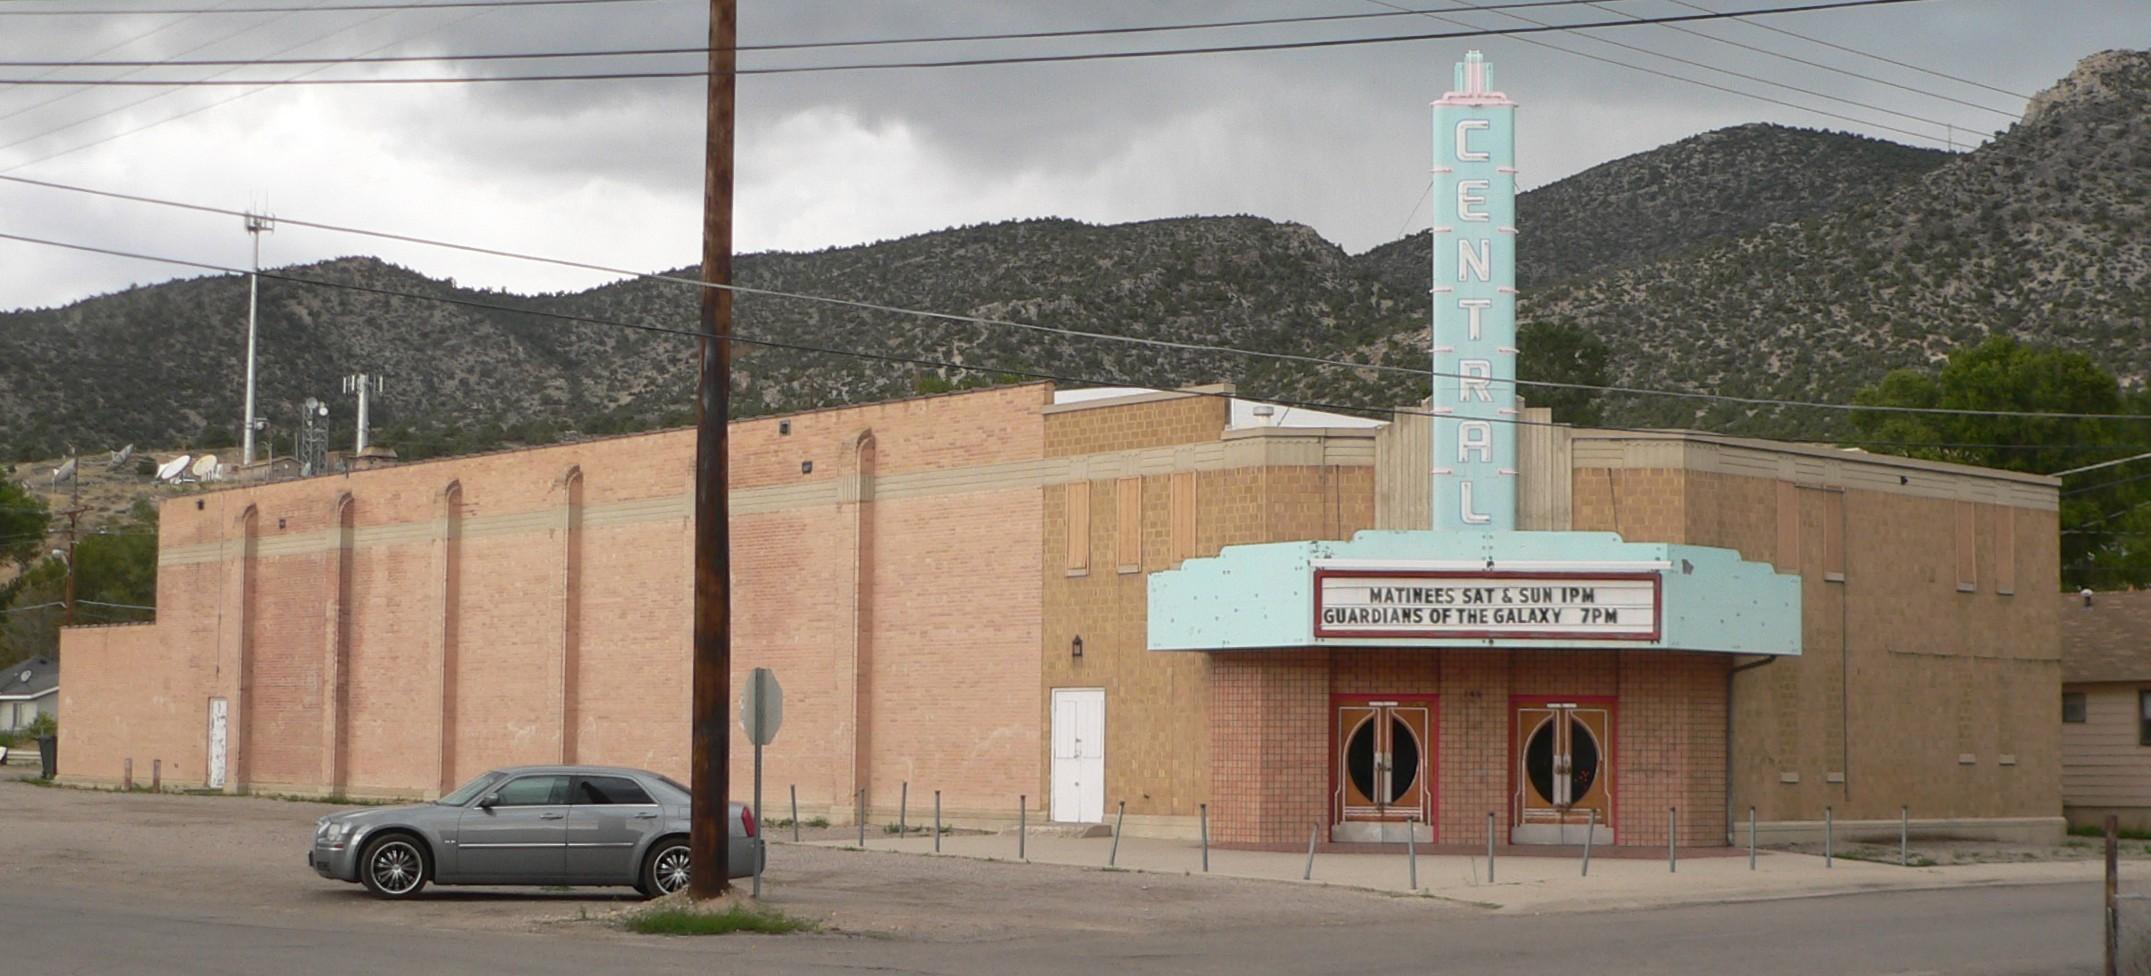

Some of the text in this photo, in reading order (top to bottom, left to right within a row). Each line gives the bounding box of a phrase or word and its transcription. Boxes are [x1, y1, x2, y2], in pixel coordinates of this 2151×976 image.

[1455, 119, 1493, 525] CENTRAL
[1370, 587, 1595, 604] MATINEES SAT & SUN 1PM
[1324, 608, 1618, 624] GUARDIANS OF THE GALAXY 7PM
